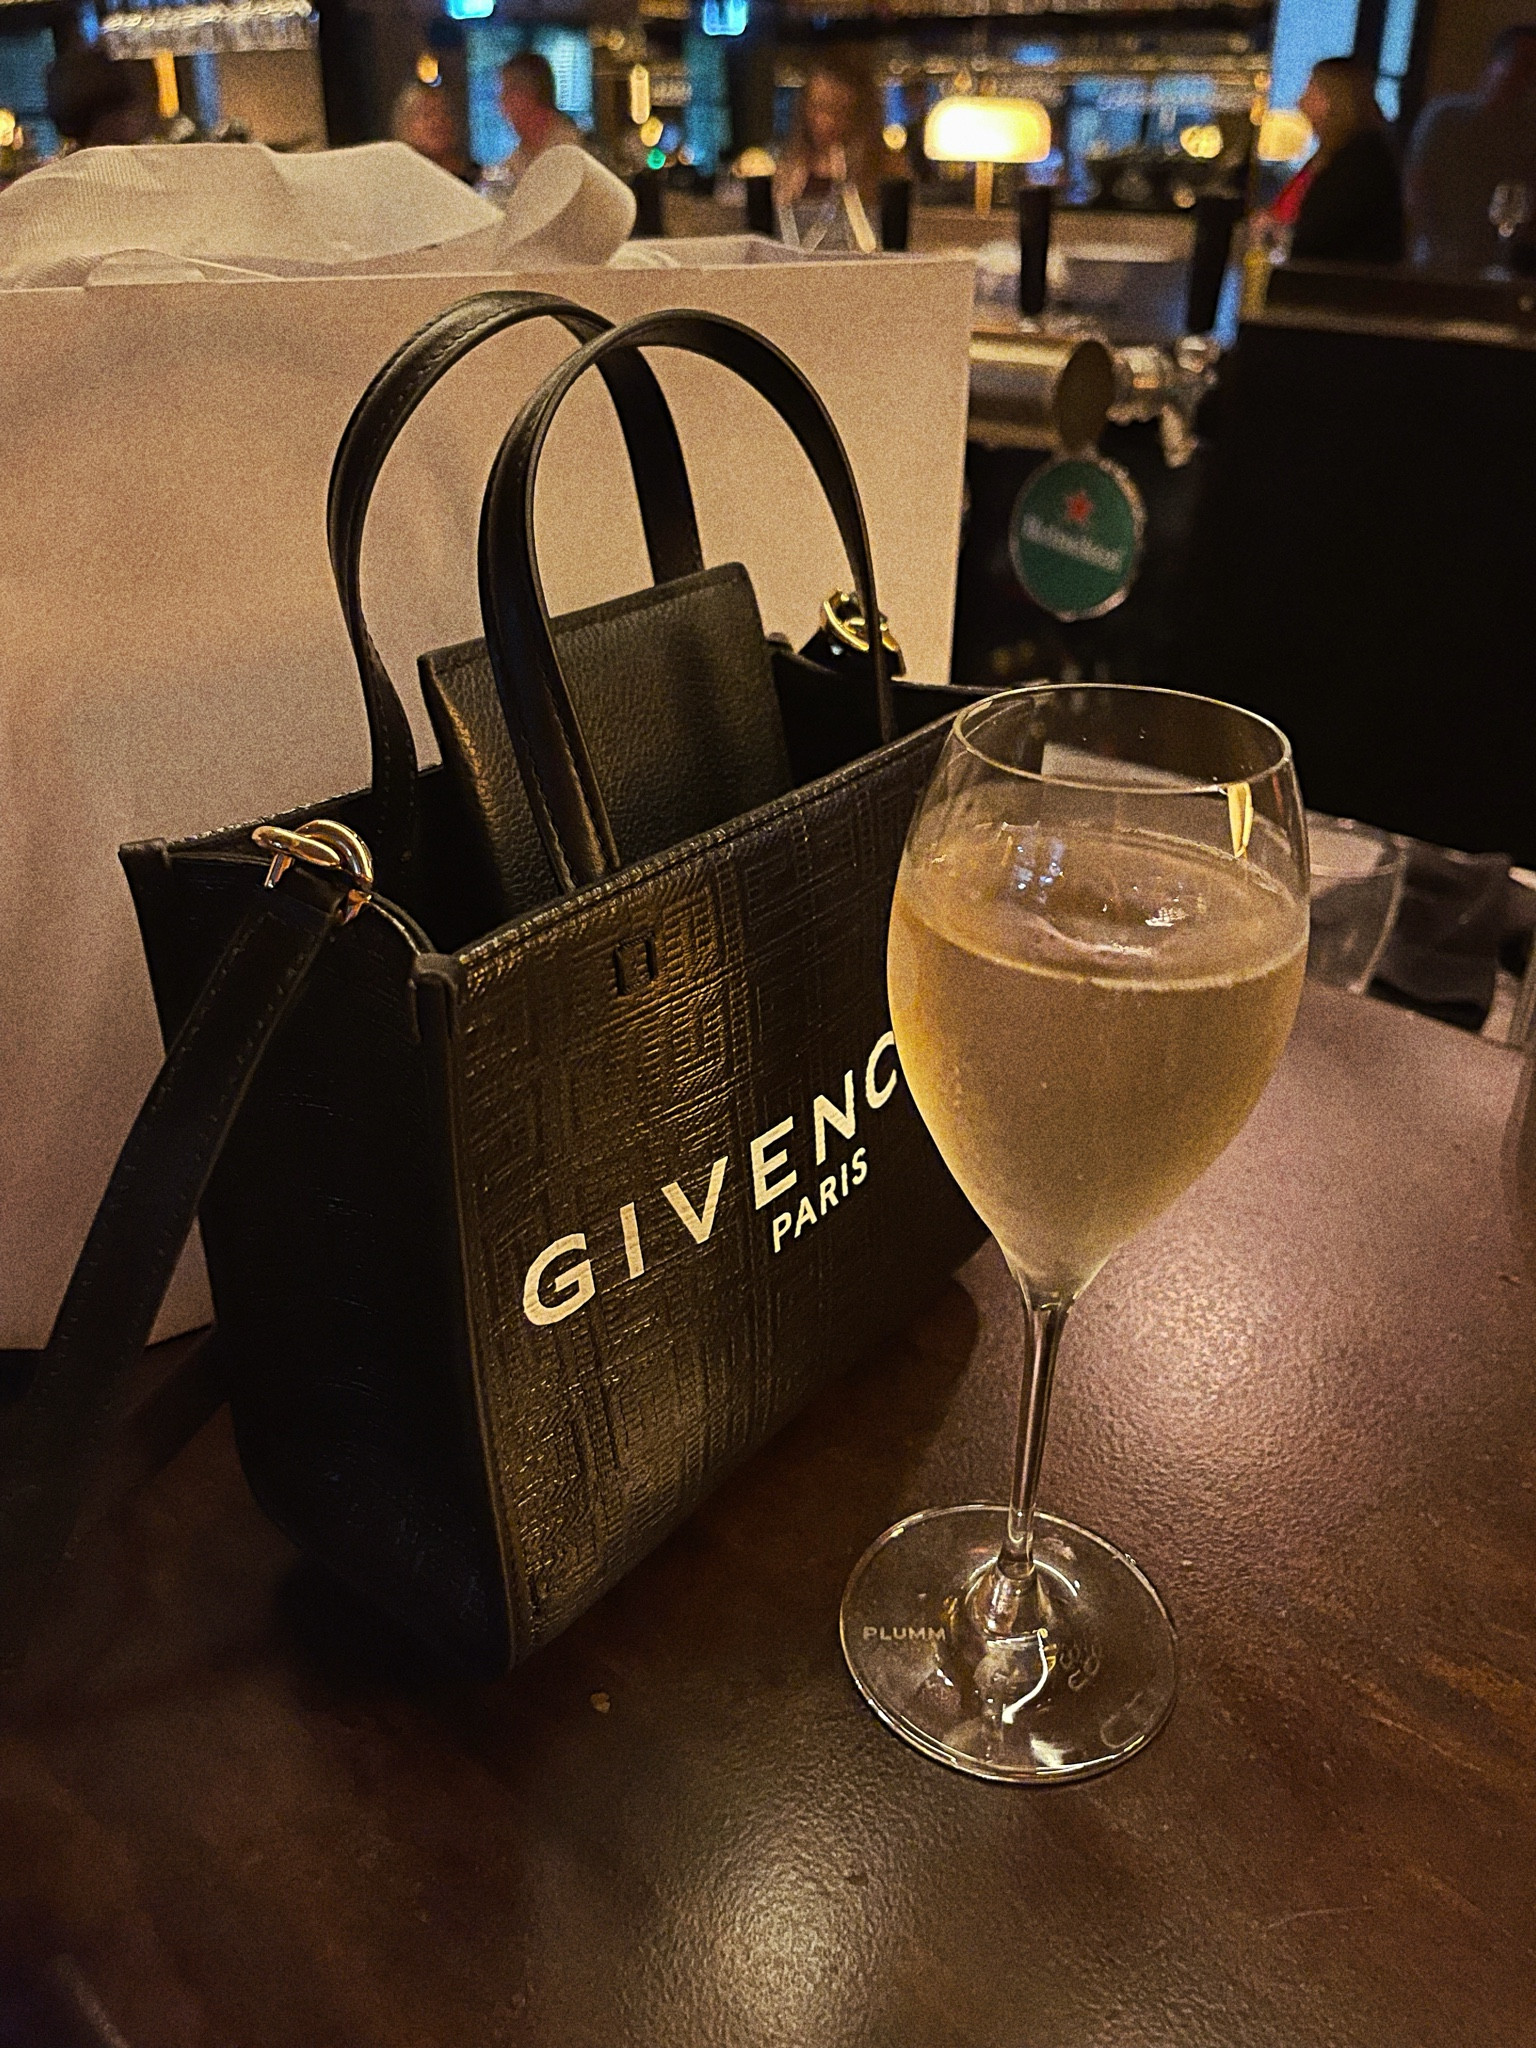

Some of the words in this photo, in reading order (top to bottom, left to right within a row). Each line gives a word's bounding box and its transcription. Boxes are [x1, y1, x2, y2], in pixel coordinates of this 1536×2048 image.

[522, 1030, 898, 1326] GIVENC
[772, 1147, 868, 1254] PARIS
[862, 1626, 946, 1641] PLUMM
